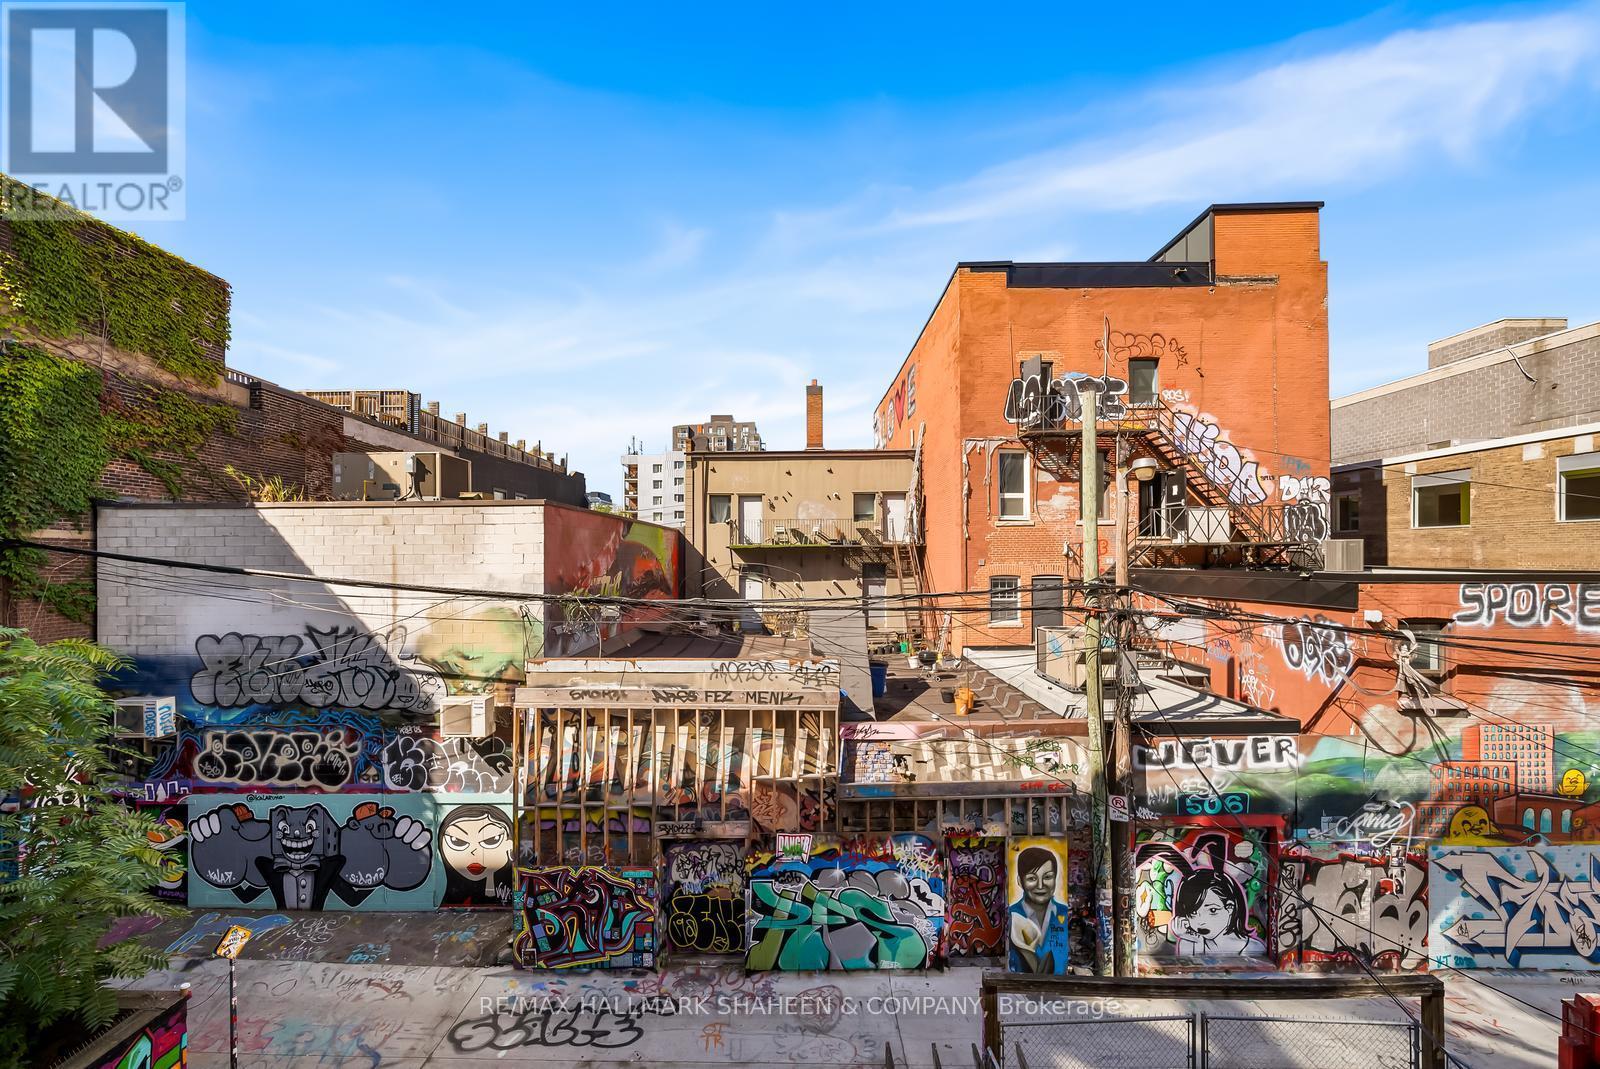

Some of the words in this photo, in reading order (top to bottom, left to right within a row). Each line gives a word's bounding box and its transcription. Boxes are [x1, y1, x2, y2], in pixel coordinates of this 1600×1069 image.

[1452, 583, 1600, 632] SPORE
[704, 691, 735, 702] FEZ
[1186, 795, 1245, 815] 506
[778, 836, 810, 853] DANGER
